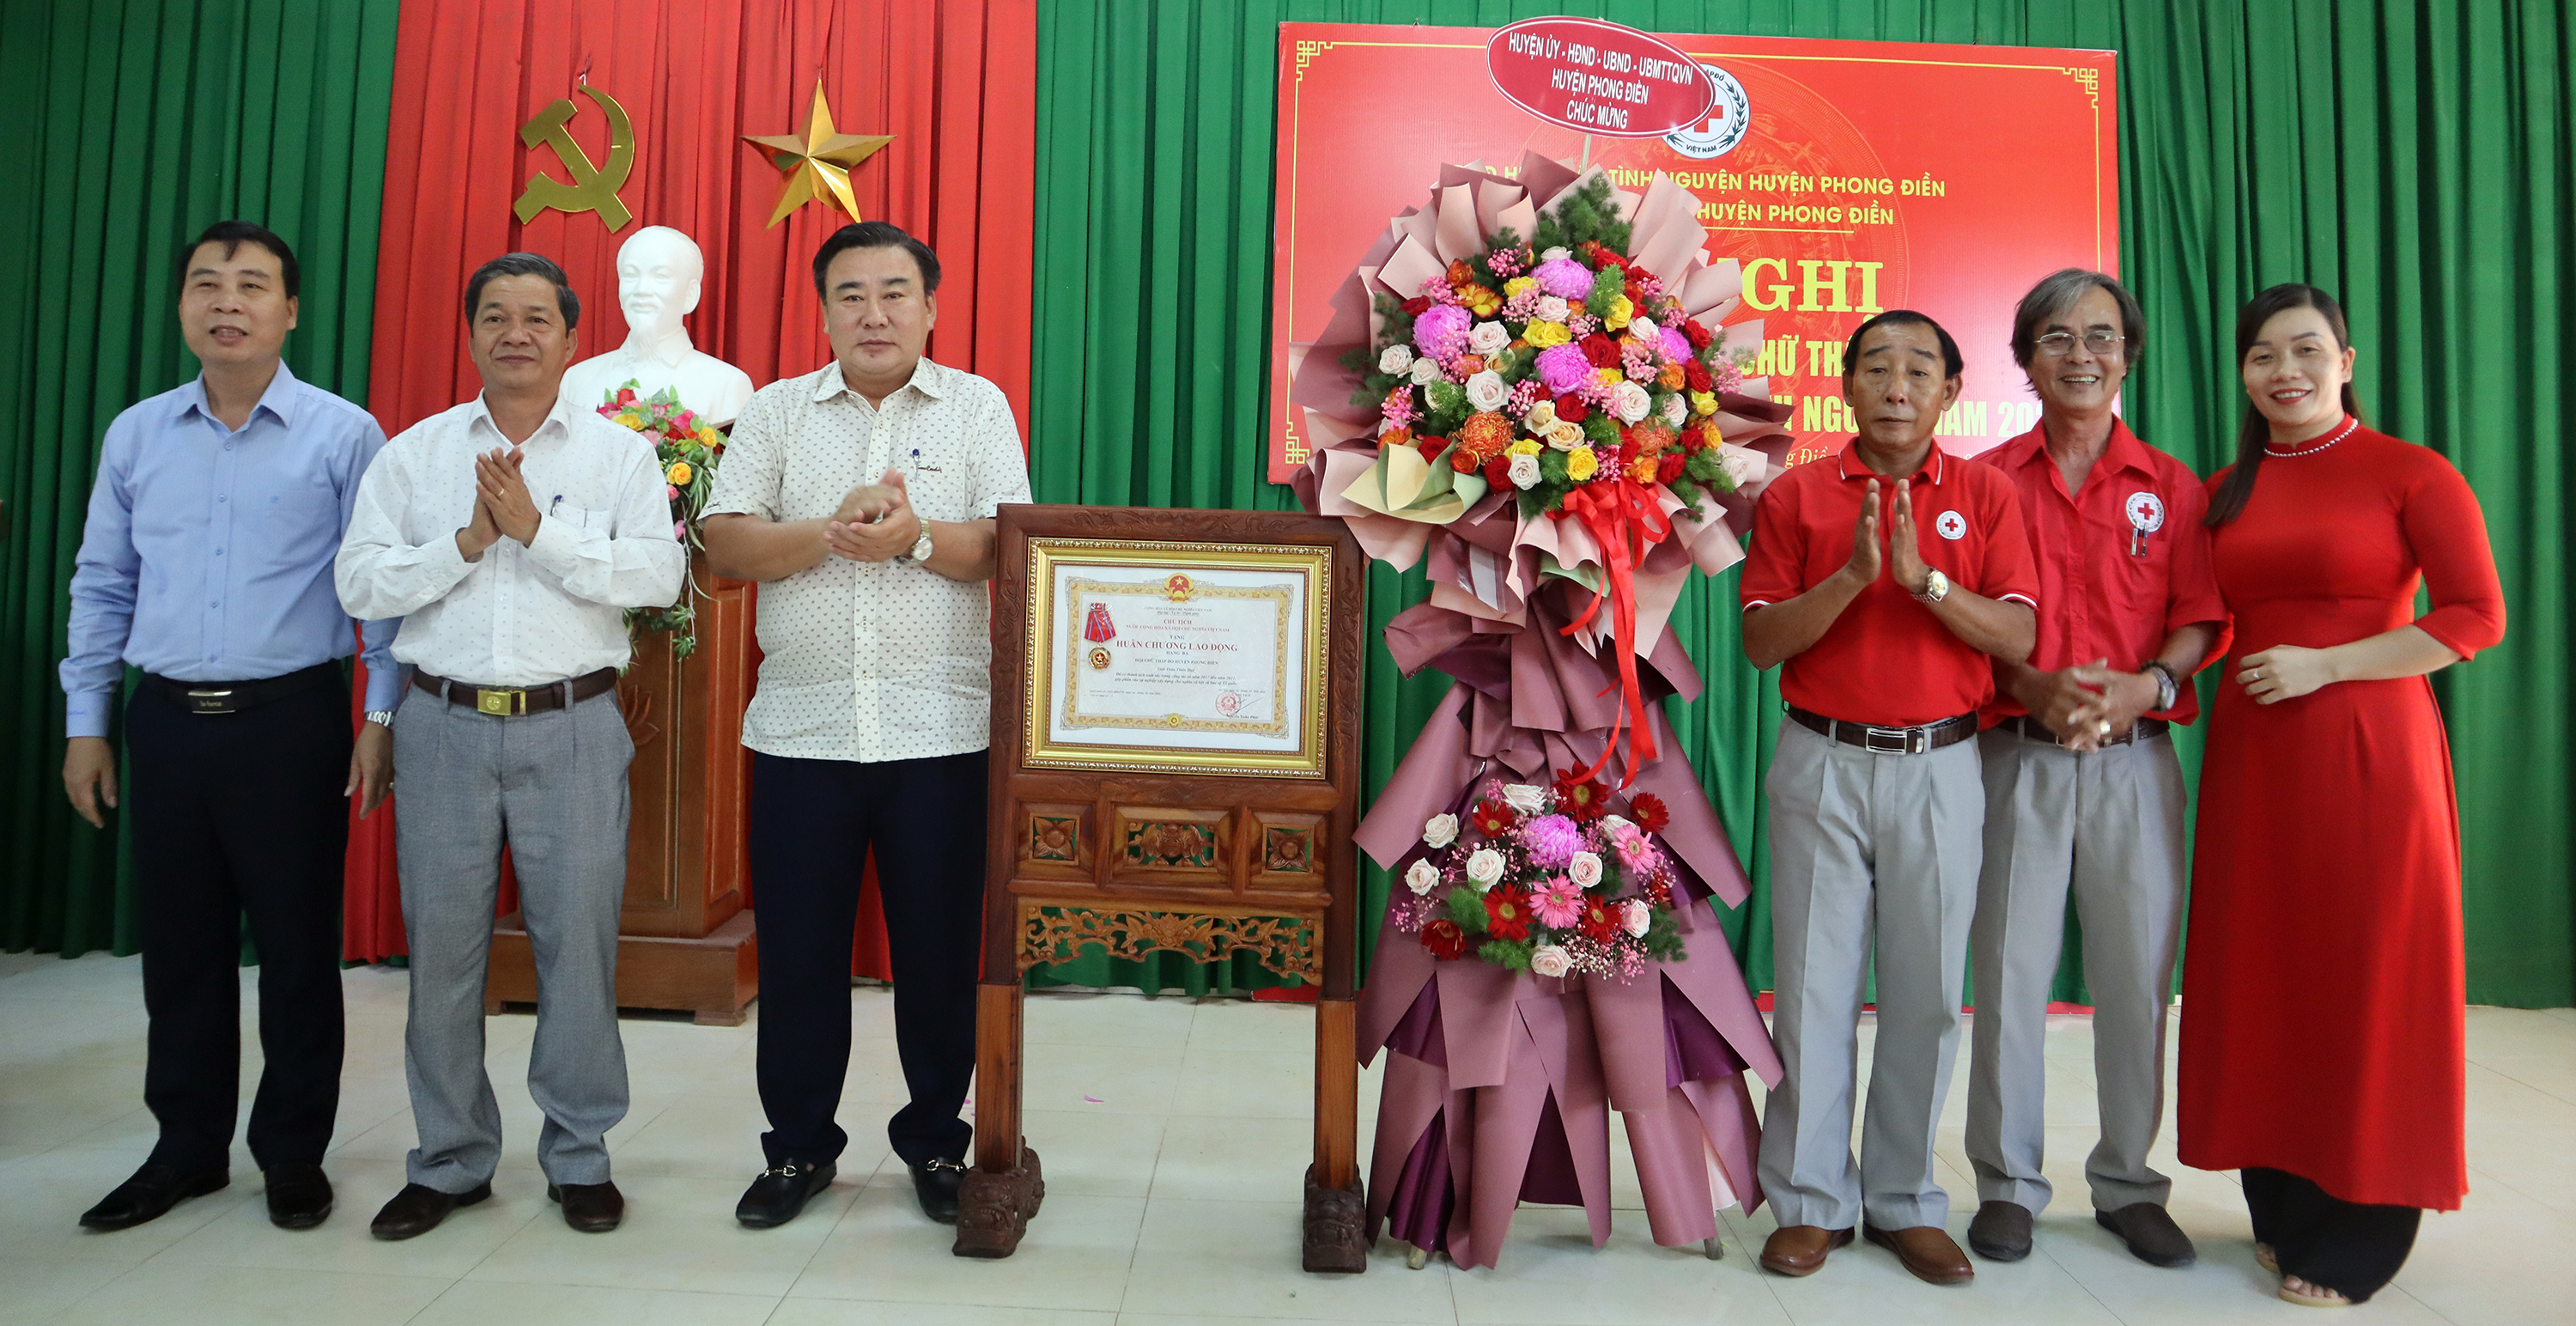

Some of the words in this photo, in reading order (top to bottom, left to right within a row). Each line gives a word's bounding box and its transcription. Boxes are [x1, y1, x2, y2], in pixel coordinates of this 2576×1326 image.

[1509, 32, 1544, 60] HUYỆN
[1546, 34, 1561, 59] ỦY
[1567, 42, 1595, 66] HĐND
[1603, 50, 1631, 73] UBND
[1639, 57, 1693, 85] UBMTTQVN
[1552, 68, 1587, 96] HUYỆN
[1588, 75, 1624, 100] PHONG
[1625, 79, 1649, 105] ĐIỀN
[1566, 97, 1595, 124] CHÚC
[1597, 101, 1628, 129] MỪNG
[1686, 144, 1701, 154] VIỆT
[1608, 165, 1653, 186] TÌNH
[1749, 171, 1814, 197] HUYỆN
[1821, 176, 1893, 195] PHONG
[1900, 171, 1946, 197] ĐIỀN
[1697, 199, 1761, 225] HUYỆN
[1768, 205, 1842, 223] PHONG
[1849, 199, 1893, 225] ĐIỀN
[1717, 258, 1884, 324] GHỊ
[1116, 639, 1143, 648] HUÂN
[1145, 641, 1186, 650] CHƯƠNG
[1188, 642, 1209, 651] LAO
[1211, 642, 1238, 653] ĐỘNG
